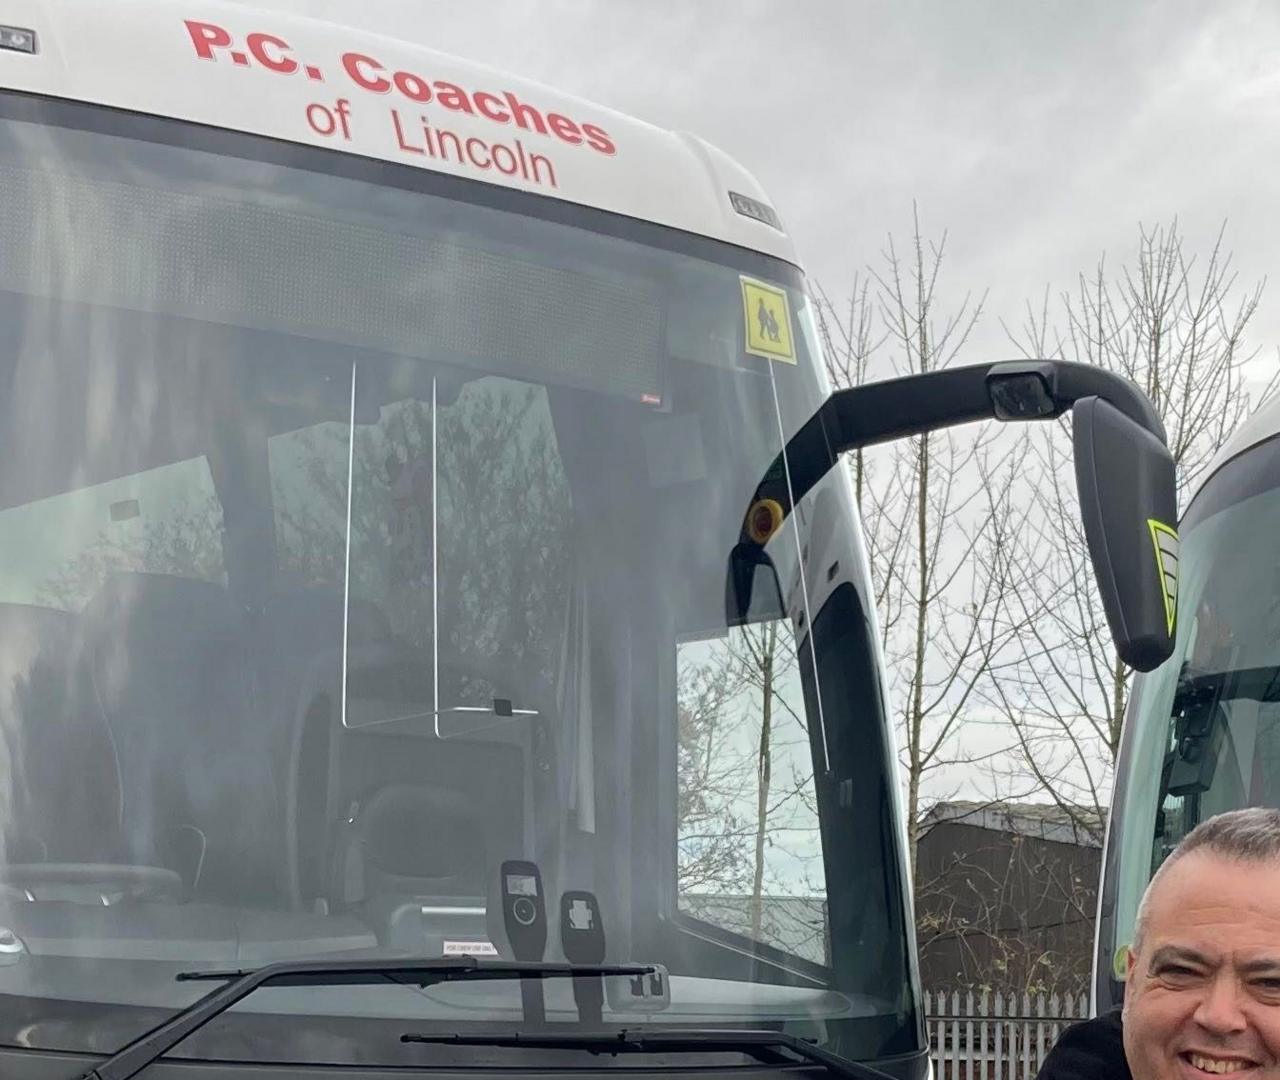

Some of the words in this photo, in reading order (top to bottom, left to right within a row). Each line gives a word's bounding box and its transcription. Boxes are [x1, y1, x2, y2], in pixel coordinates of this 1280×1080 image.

[183, 19, 322, 81] P.C.
[341, 51, 617, 157] Coaches
[306, 98, 352, 141] of
[393, 108, 558, 189] Lincoln
